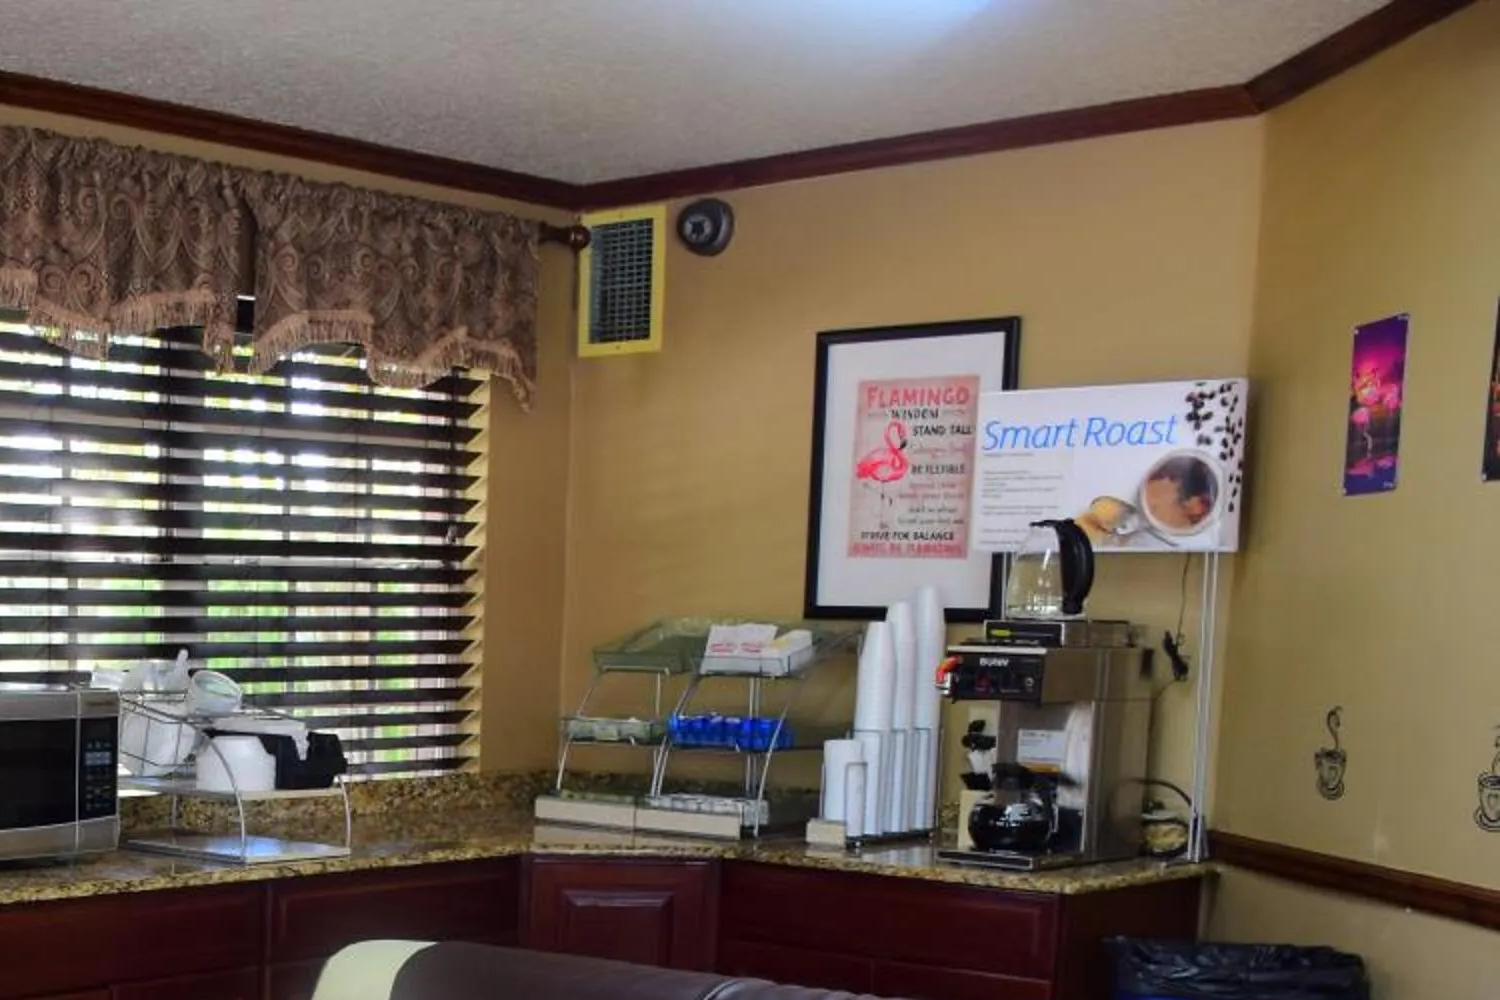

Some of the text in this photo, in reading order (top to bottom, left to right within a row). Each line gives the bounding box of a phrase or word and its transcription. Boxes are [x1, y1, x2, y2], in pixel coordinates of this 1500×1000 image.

[867, 386, 970, 408] FLAMINGO
[912, 424, 972, 436] STAND TALL
[981, 418, 1080, 450] Smart
[1083, 415, 1179, 447] Roast
